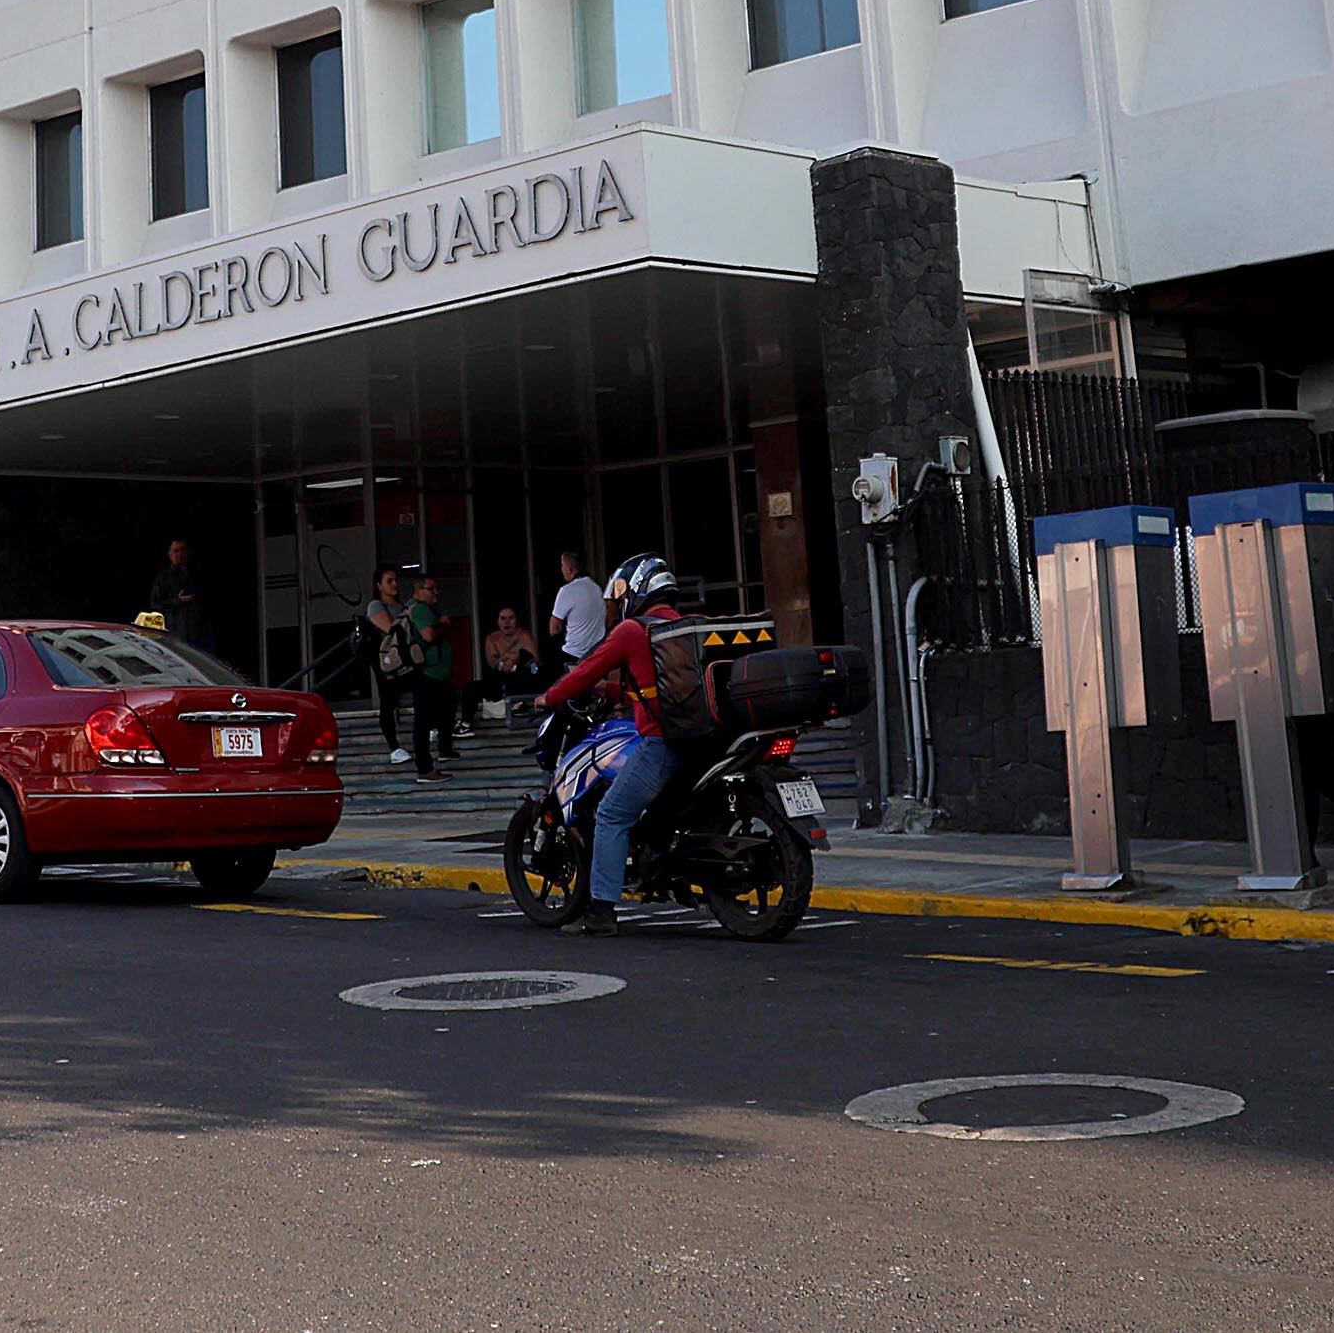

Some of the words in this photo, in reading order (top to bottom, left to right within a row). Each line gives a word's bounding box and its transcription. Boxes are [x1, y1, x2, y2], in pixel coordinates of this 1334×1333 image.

[72, 233, 331, 351] CALDERON
[357, 159, 635, 282] GUARDIA
[228, 734, 254, 750] 5975
